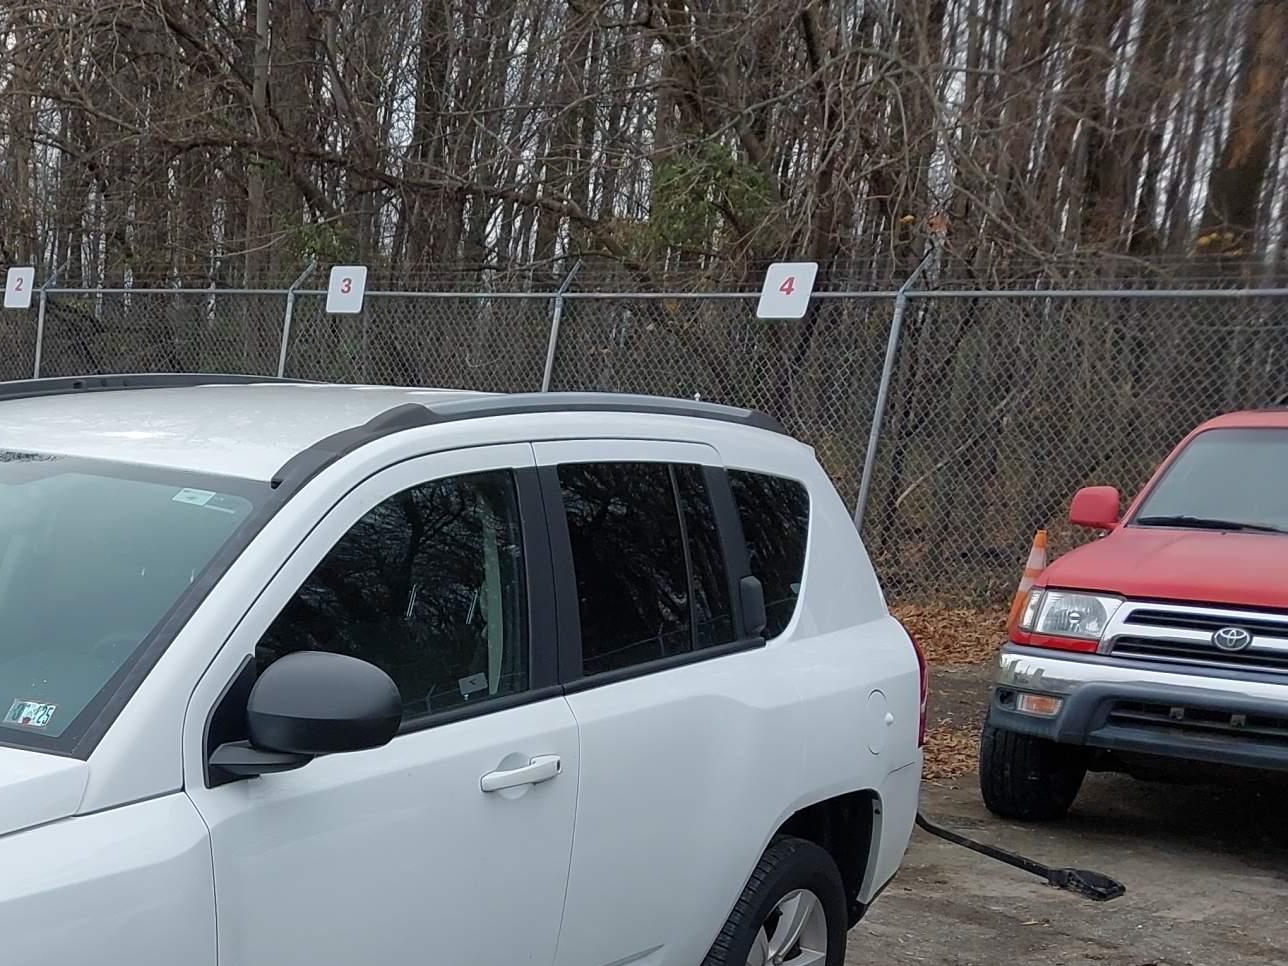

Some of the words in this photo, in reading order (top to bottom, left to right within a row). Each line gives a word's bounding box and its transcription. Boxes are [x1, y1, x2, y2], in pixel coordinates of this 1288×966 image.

[14, 277, 23, 292] 2
[341, 277, 352, 294] 3
[779, 276, 795, 295] 4
